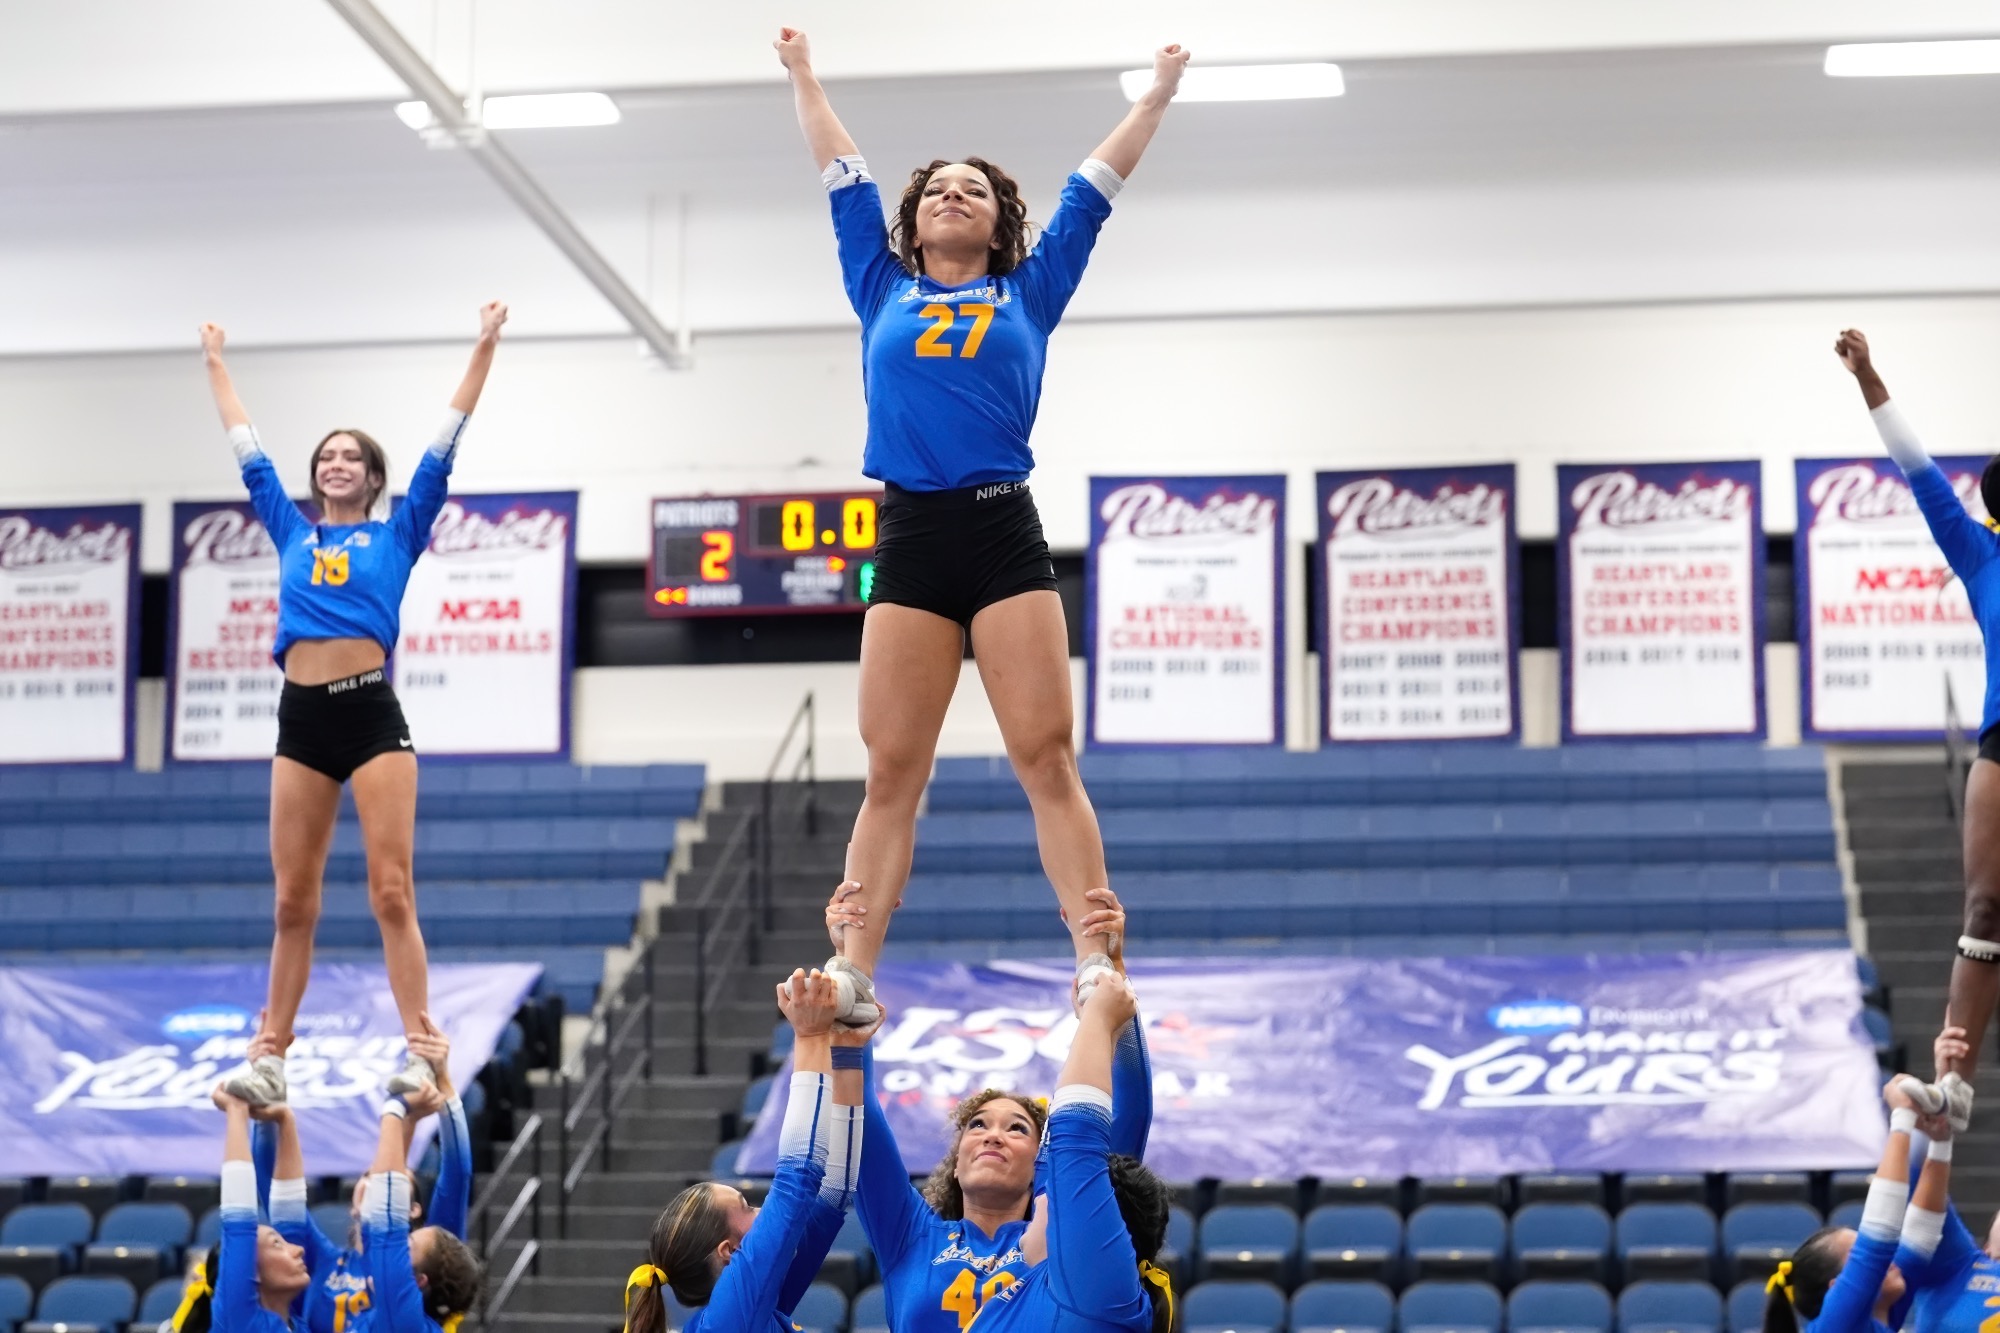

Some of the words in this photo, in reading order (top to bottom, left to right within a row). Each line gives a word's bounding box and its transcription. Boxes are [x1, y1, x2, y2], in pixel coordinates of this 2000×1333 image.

[915, 303, 995, 358] 27
[976, 482, 1012, 501] NIKE
[1572, 472, 1749, 533] Patriots
[1101, 483, 1276, 543] Patriots
[1328, 478, 1505, 541] Patriots
[701, 531, 734, 581] 2
[1351, 569, 1486, 588] HEARTLAND
[1593, 565, 1731, 581] HEARTLAND
[438, 599, 521, 622] NCAA
[1343, 593, 1496, 614] CONFERENCE
[1584, 590, 1738, 609] CONFERENCE
[0, 604, 110, 621] EARTLAND
[1124, 606, 1249, 624] NATIONAL
[1820, 604, 1976, 625] NATIONAL
[0, 624, 115, 643] NFERENCE
[1340, 619, 1498, 641] CHAMPIONS
[1585, 614, 1741, 634] CHAMPIONS
[404, 631, 552, 656] NATIONALS
[1110, 630, 1263, 649] CHAMPIONS
[0, 650, 115, 671] HAMPIONS
[327, 677, 358, 695] NIKE
[360, 669, 383, 687] PRO
[1496, 1006, 1582, 1028] NCAA
[1547, 1031, 1722, 1052] MAKE
[1730, 1029, 1789, 1051] IT
[883, 1069, 1016, 1094] ONE
[1405, 1036, 1785, 1110] YOURS
